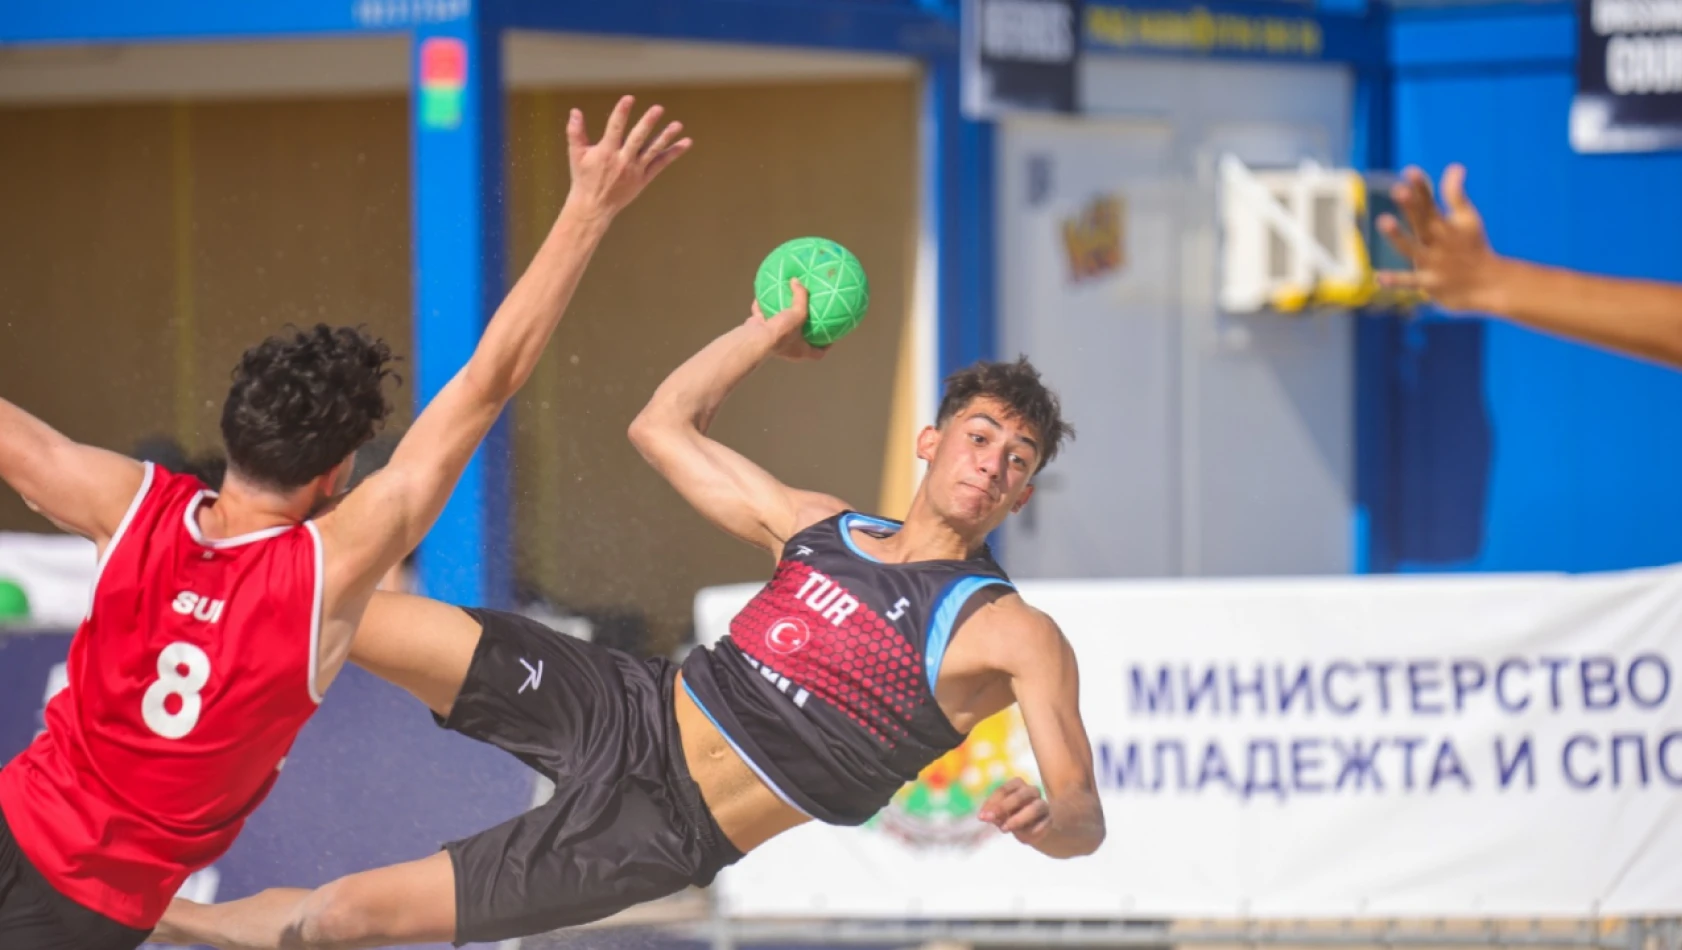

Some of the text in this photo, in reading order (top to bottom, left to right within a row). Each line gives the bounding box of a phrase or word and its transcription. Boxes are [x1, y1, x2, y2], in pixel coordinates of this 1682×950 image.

[172, 590, 225, 623] SUI
[794, 571, 859, 626] TUR
[885, 596, 910, 621] 5
[141, 641, 211, 739] 8
[1129, 653, 1670, 714] МИНИСТЕРСТВО
[1099, 736, 1471, 803] МЛАДЕЖТА
[1493, 735, 1535, 789] И
